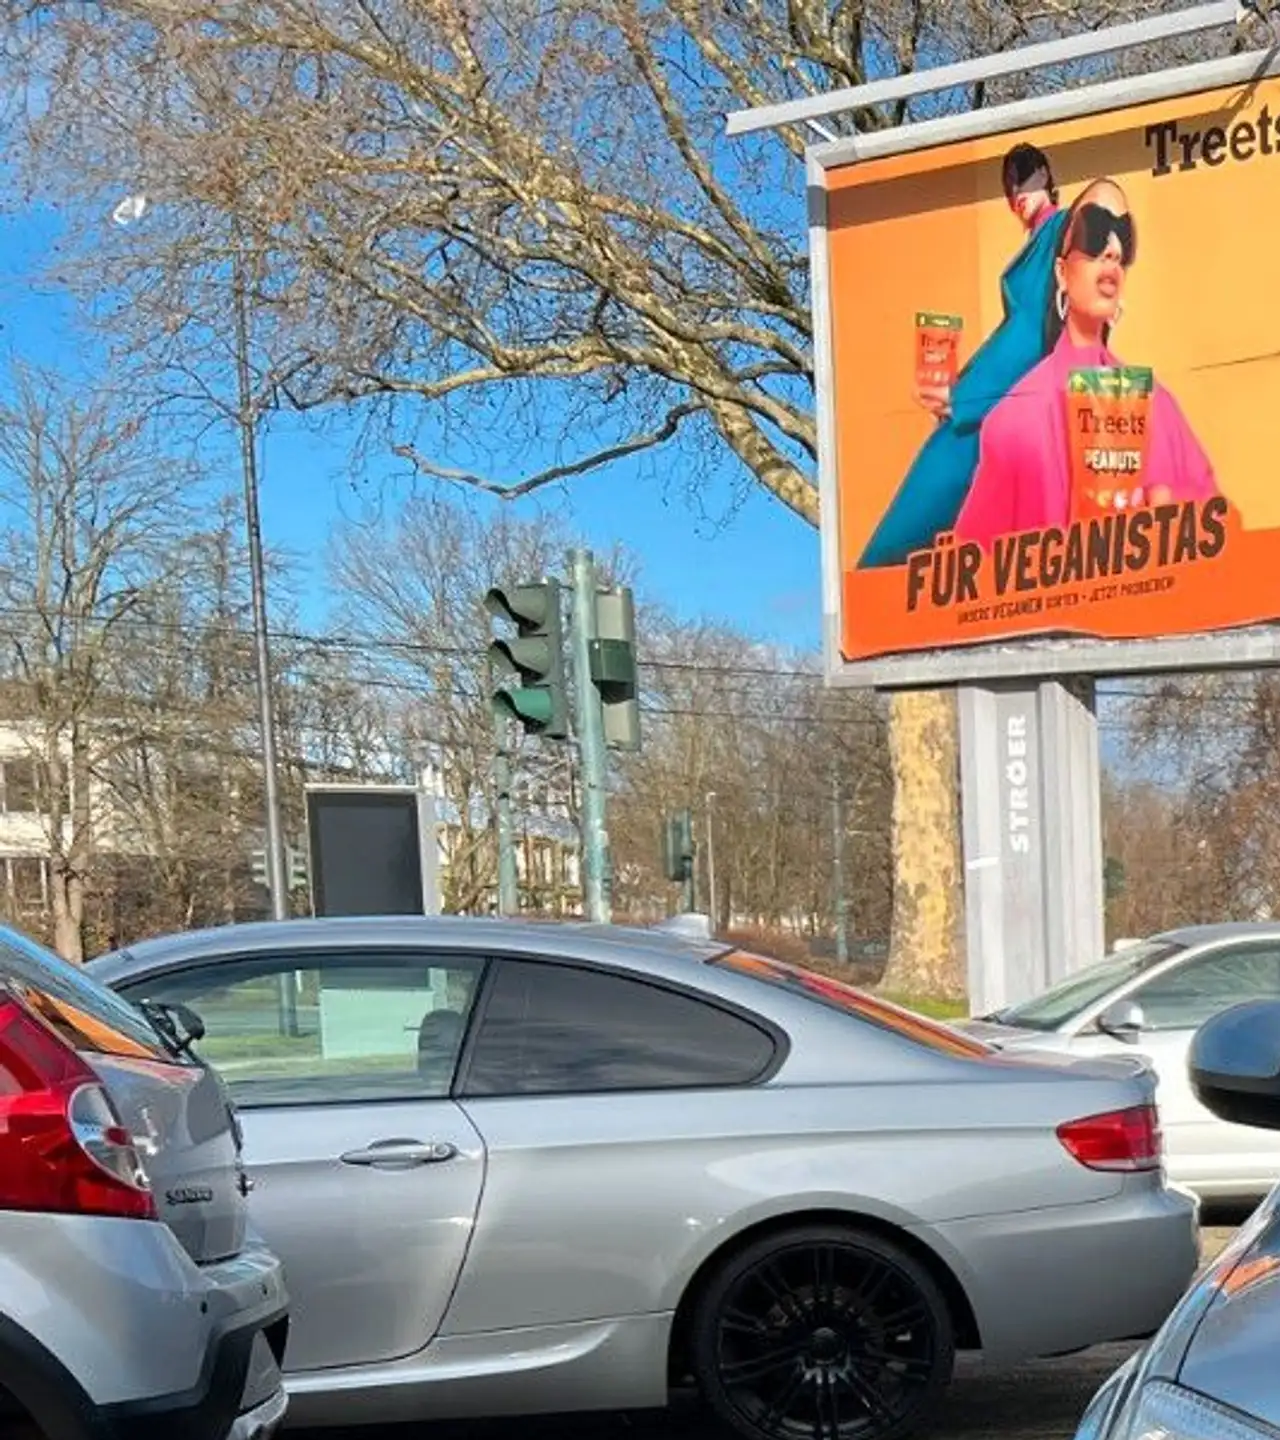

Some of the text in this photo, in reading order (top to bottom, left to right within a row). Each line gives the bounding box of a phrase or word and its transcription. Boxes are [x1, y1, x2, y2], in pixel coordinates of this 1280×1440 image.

[1077, 408, 1146, 436] Treets
[906, 496, 1228, 613] FÜR VEGANISTAS
[1005, 714, 1030, 854] STRÖER
